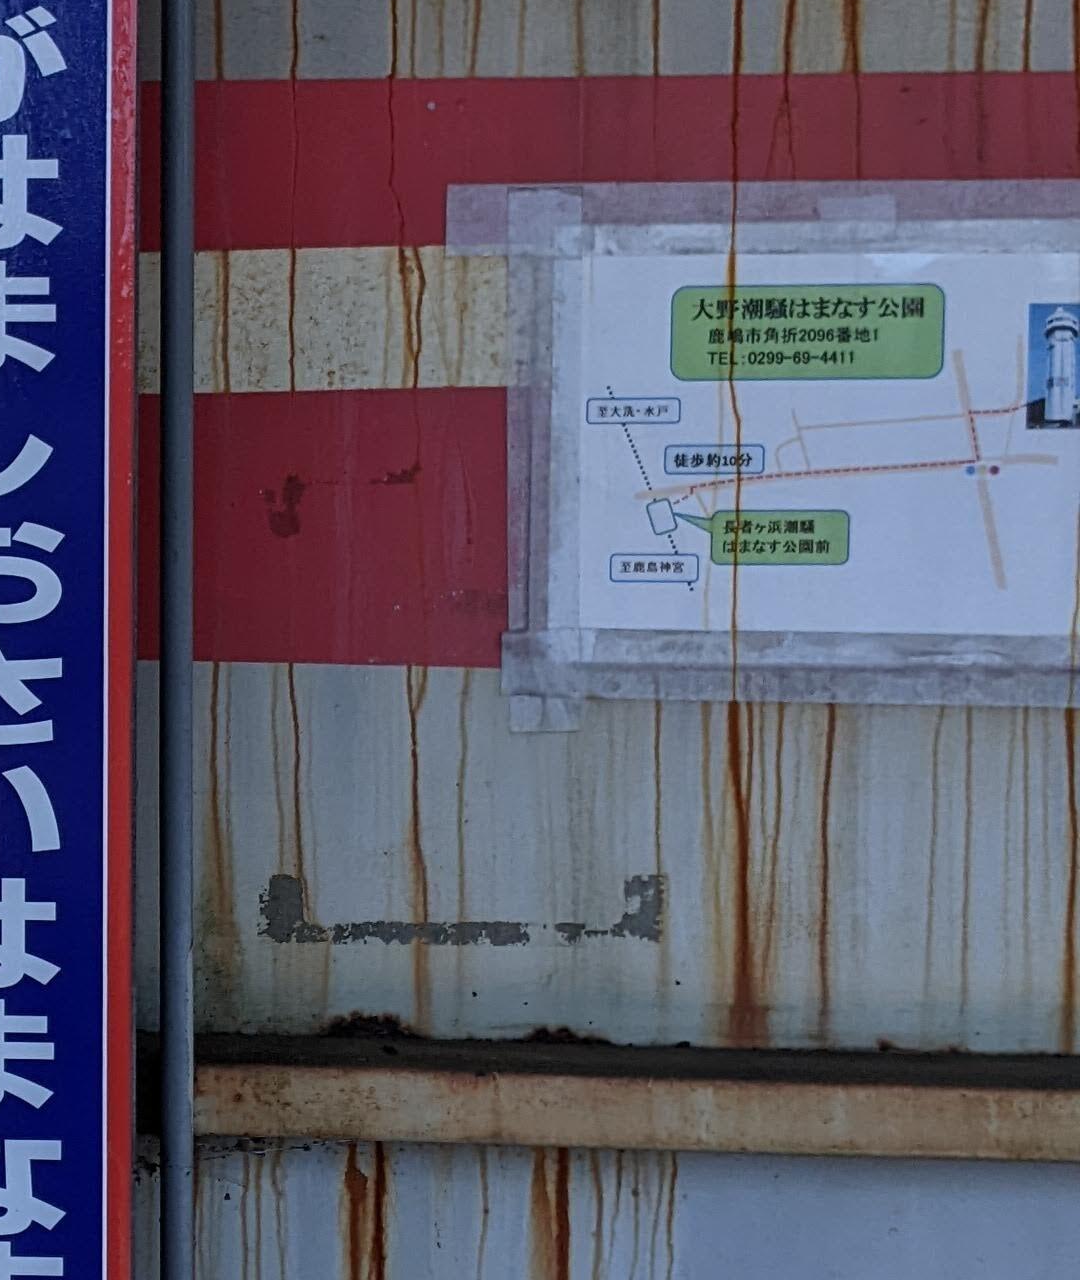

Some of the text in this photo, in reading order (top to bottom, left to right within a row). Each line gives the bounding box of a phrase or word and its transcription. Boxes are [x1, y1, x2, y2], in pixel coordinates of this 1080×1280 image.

[692, 296, 924, 321] 大野潮騒はまなす公園
[707, 351, 855, 366] TEL:0299-69-4411
[674, 452, 753, 468] 徒歩約10分
[722, 539, 831, 555] はまなす公園前
